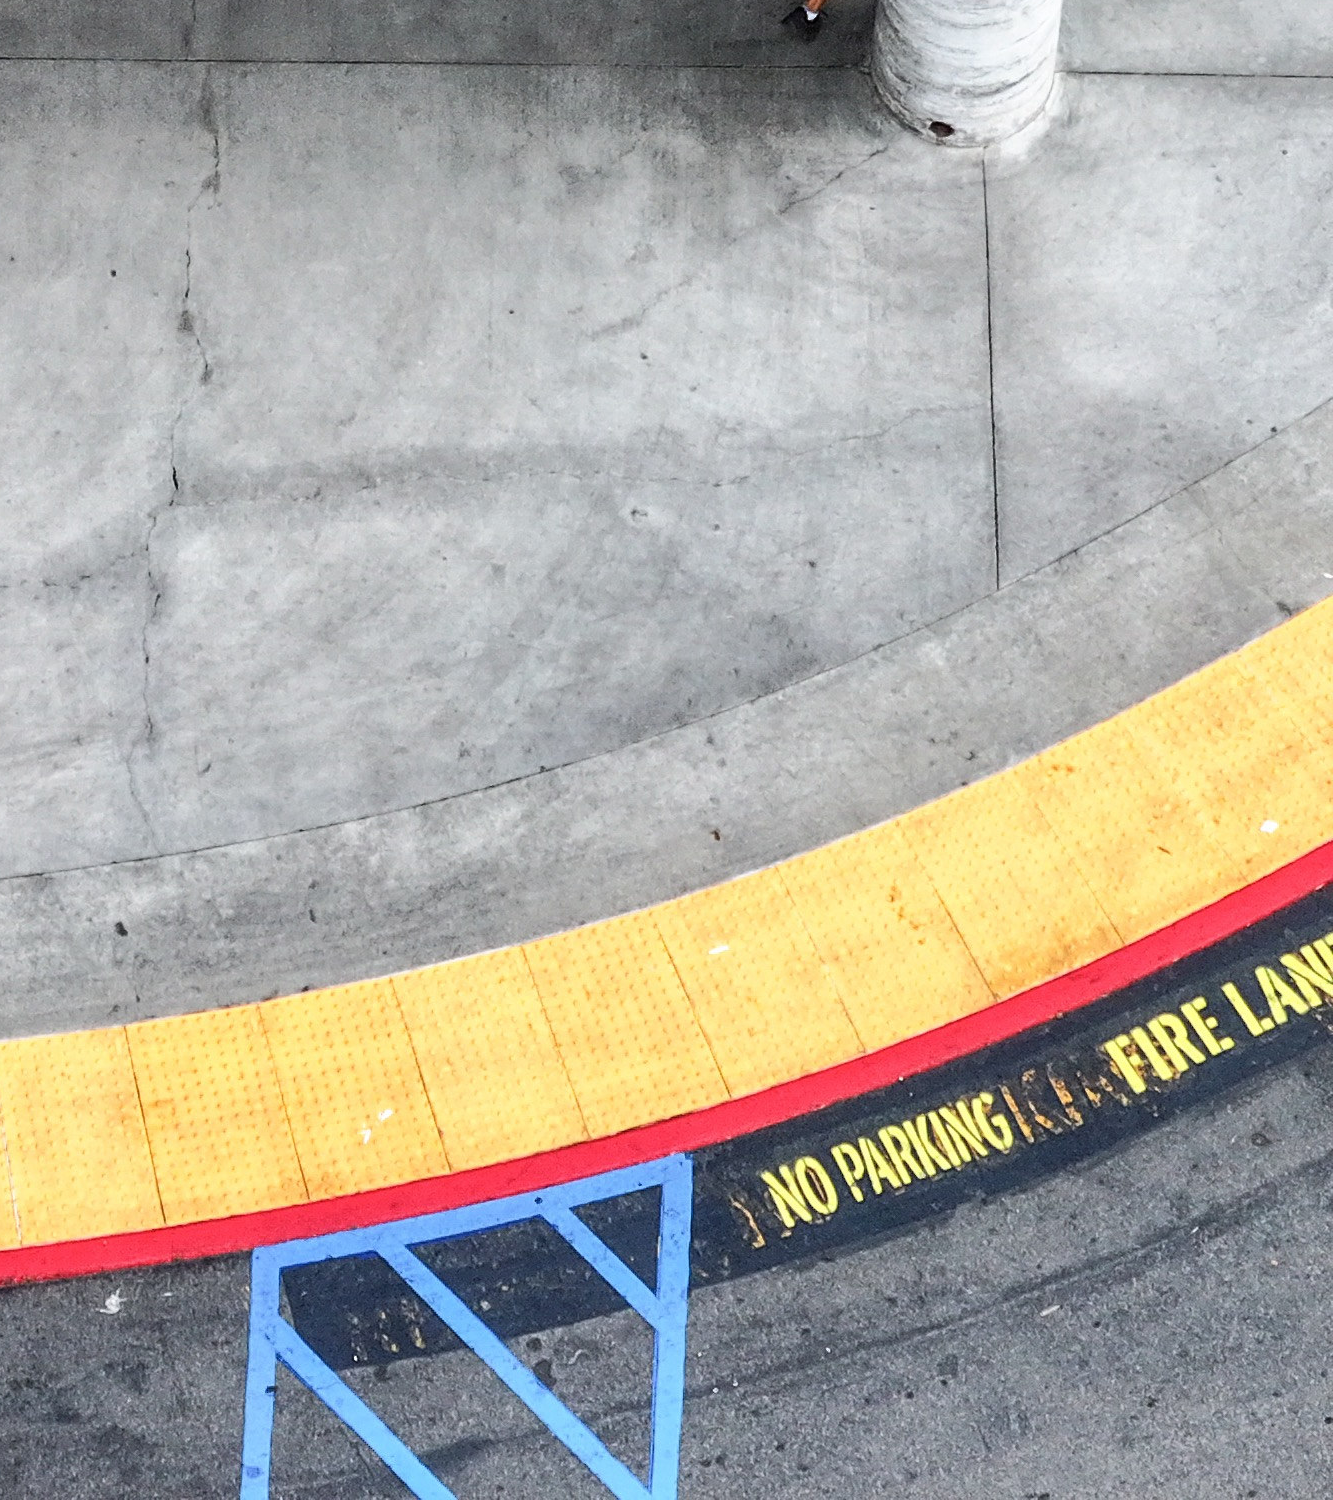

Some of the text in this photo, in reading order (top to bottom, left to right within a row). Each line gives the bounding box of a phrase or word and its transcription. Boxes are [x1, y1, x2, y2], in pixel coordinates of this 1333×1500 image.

[761, 1156, 838, 1228] NO
[831, 1091, 1014, 1202] PARKING
[1104, 996, 1236, 1094] FIRE
